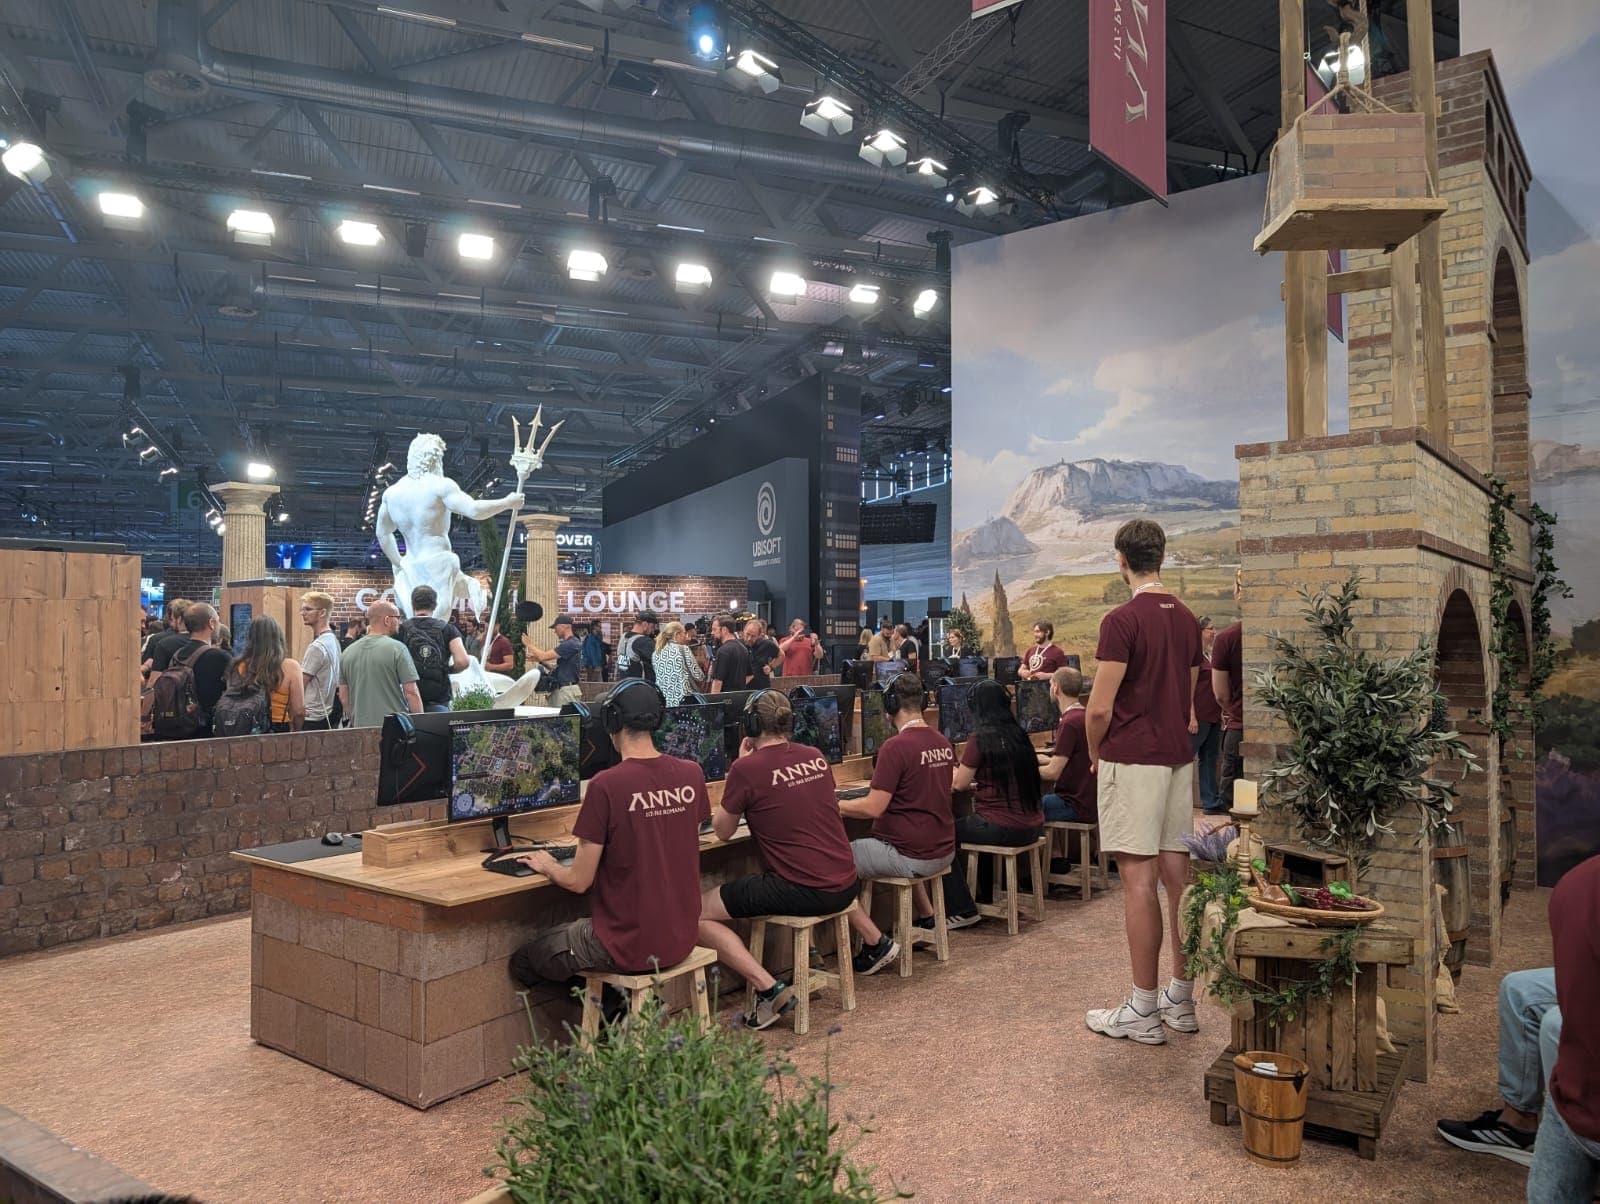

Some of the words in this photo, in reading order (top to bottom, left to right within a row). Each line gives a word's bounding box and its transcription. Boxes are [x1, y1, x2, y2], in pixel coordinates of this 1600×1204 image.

[752, 536, 782, 557] UBISOFT
[567, 590, 685, 613] LOUNGE
[920, 747, 953, 765] ANNO
[771, 757, 828, 786] ANNO
[628, 785, 696, 811] ANNO
